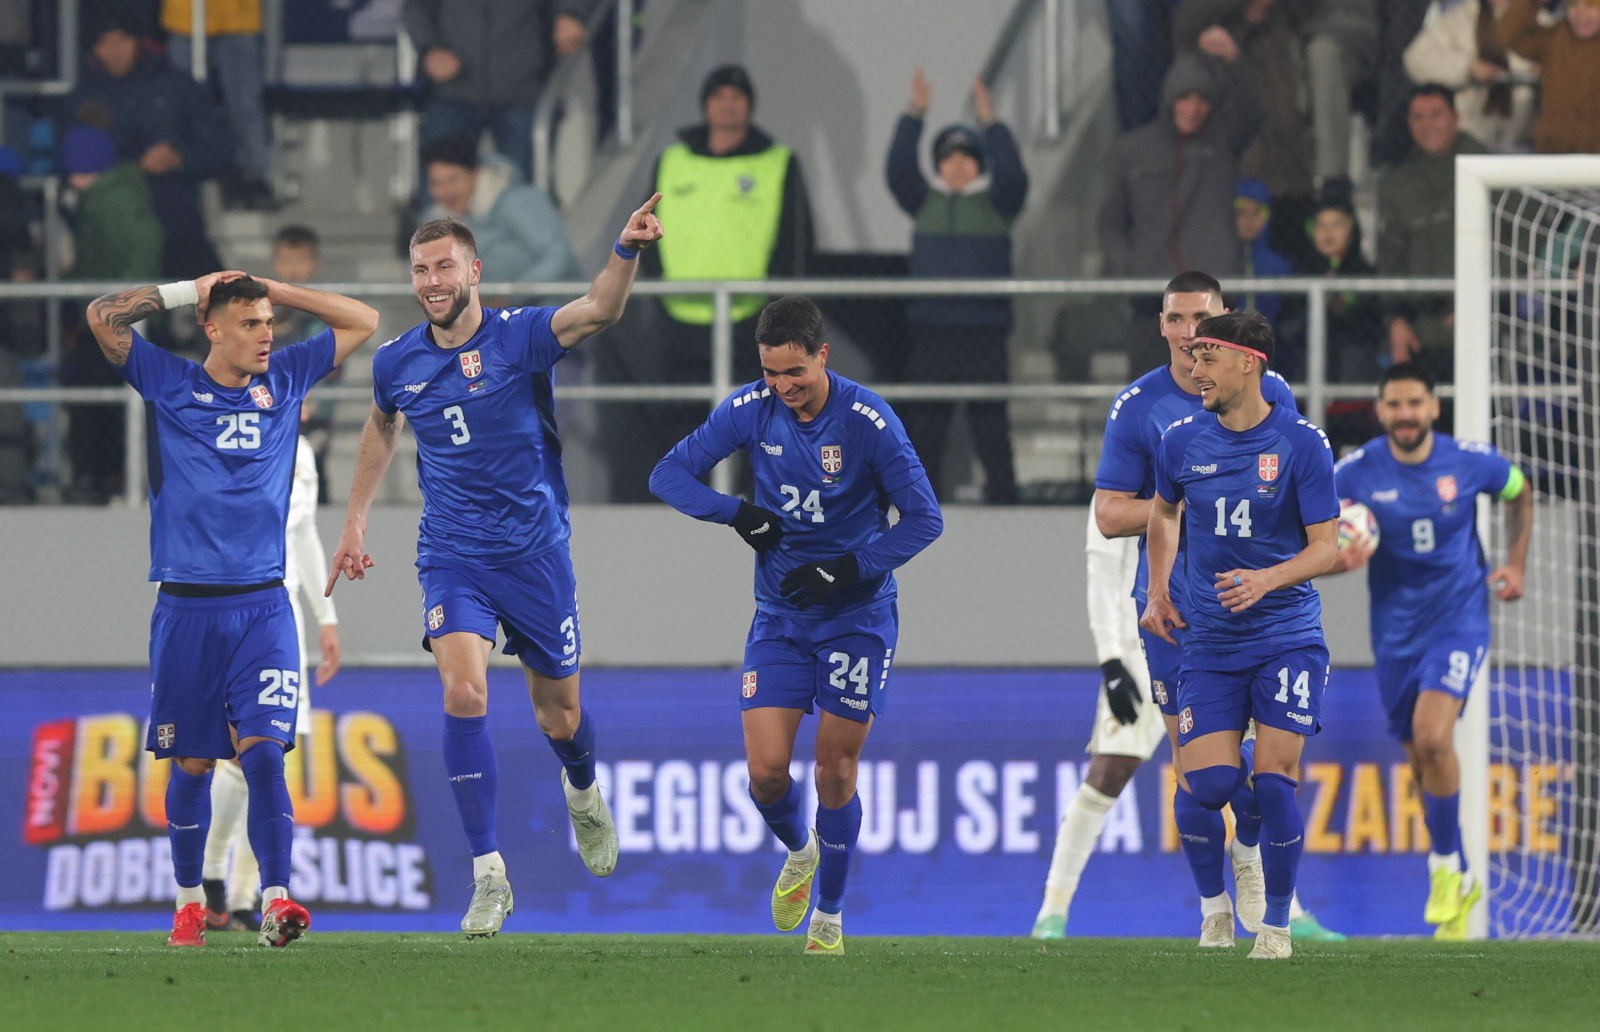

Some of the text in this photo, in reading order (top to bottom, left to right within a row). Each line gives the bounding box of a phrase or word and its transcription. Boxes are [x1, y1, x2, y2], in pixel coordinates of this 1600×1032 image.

[216, 412, 261, 449] 25
[443, 405, 471, 445] 3
[1191, 463, 1217, 474] capelli
[780, 484, 825, 522] 24
[1214, 496, 1252, 537] 14
[1412, 518, 1435, 554] 9
[560, 615, 576, 655] 3
[828, 651, 869, 695] 24
[1448, 649, 1470, 681] 9
[257, 668, 299, 709] 25
[840, 696, 868, 710] capelli
[1274, 666, 1311, 710] 14
[1286, 711, 1313, 725] capelli
[67, 708, 405, 834] BUS
[569, 759, 939, 853] EGISUJ
[954, 760, 1040, 853] SE
[43, 825, 431, 910] DOBRŠLICE
